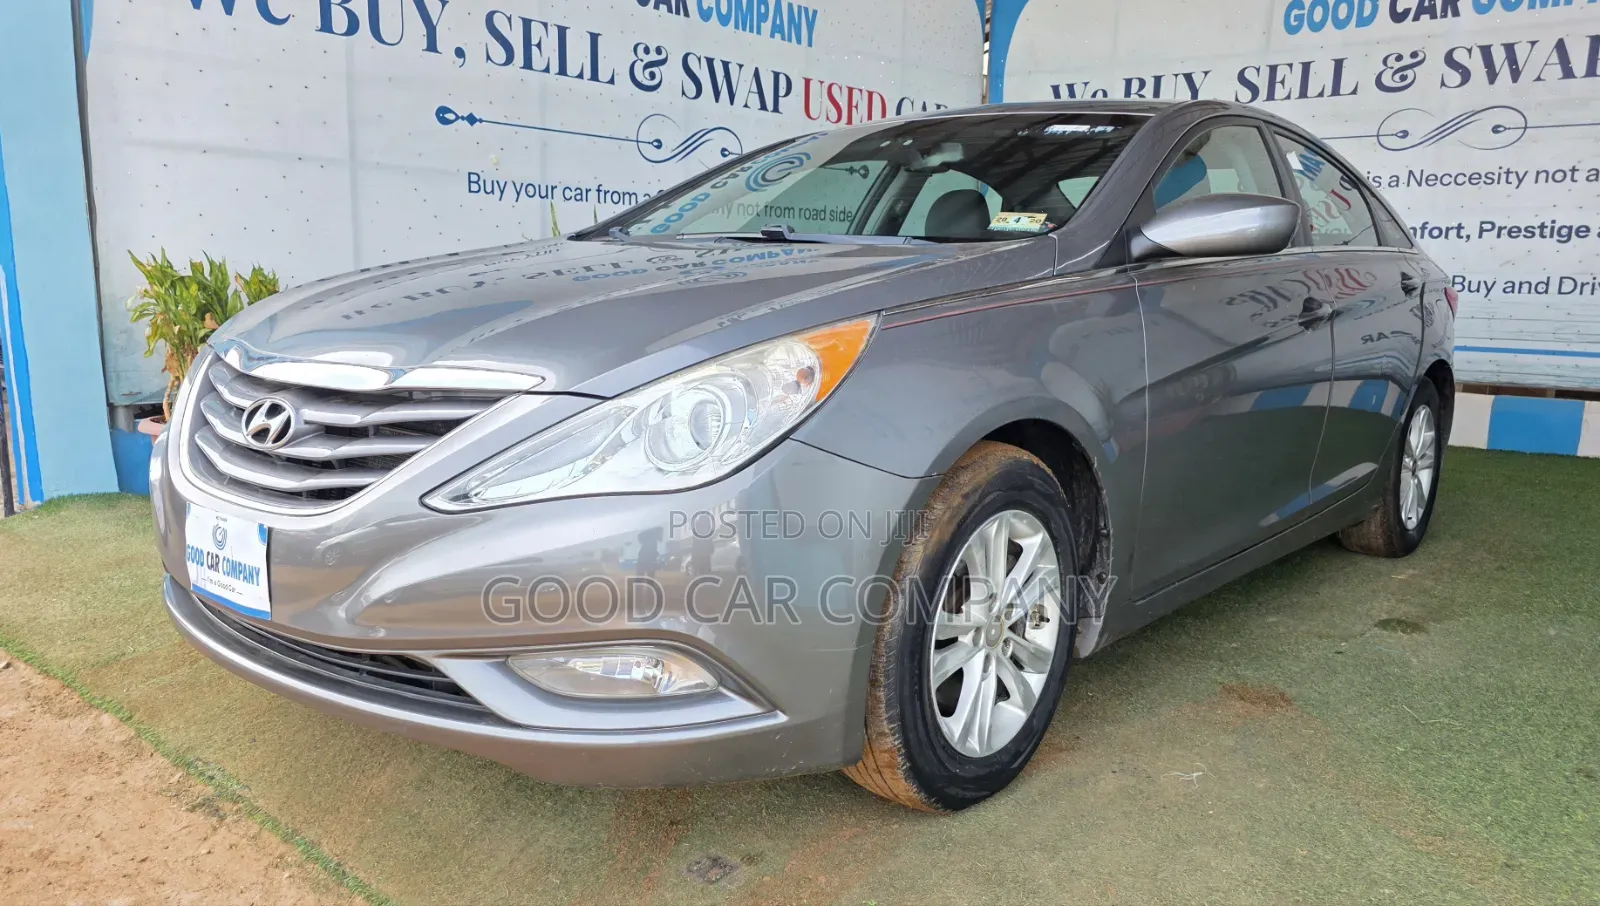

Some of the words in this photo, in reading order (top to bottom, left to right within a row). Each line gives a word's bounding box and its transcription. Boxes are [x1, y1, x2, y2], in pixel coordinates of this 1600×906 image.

[697, 0, 818, 47] COMPANY
[1284, 0, 1379, 35] GOOD
[484, 10, 615, 86] SELL
[628, 41, 669, 92] &
[681, 52, 793, 114] SWAP
[802, 76, 887, 125] USED
[1234, 57, 1359, 103] SELL
[1374, 50, 1427, 93] &
[467, 172, 508, 201] Buy
[511, 179, 558, 202] your
[562, 185, 592, 202] car
[596, 184, 638, 206] from
[1387, 174, 1400, 188] a
[1406, 166, 1529, 189] Neccesity
[1534, 165, 1580, 184] not
[1585, 168, 1600, 183] a
[736, 202, 761, 218] not
[764, 204, 796, 219] from
[798, 205, 827, 222] road
[828, 207, 853, 223] side
[1477, 219, 1591, 244] Prestige
[1451, 274, 1497, 298] Buy
[1502, 276, 1551, 295] and
[1557, 276, 1600, 296] Dri
[187, 544, 205, 567] GOOD
[206, 551, 220, 573] CAR
[222, 556, 260, 586] COMPANY
